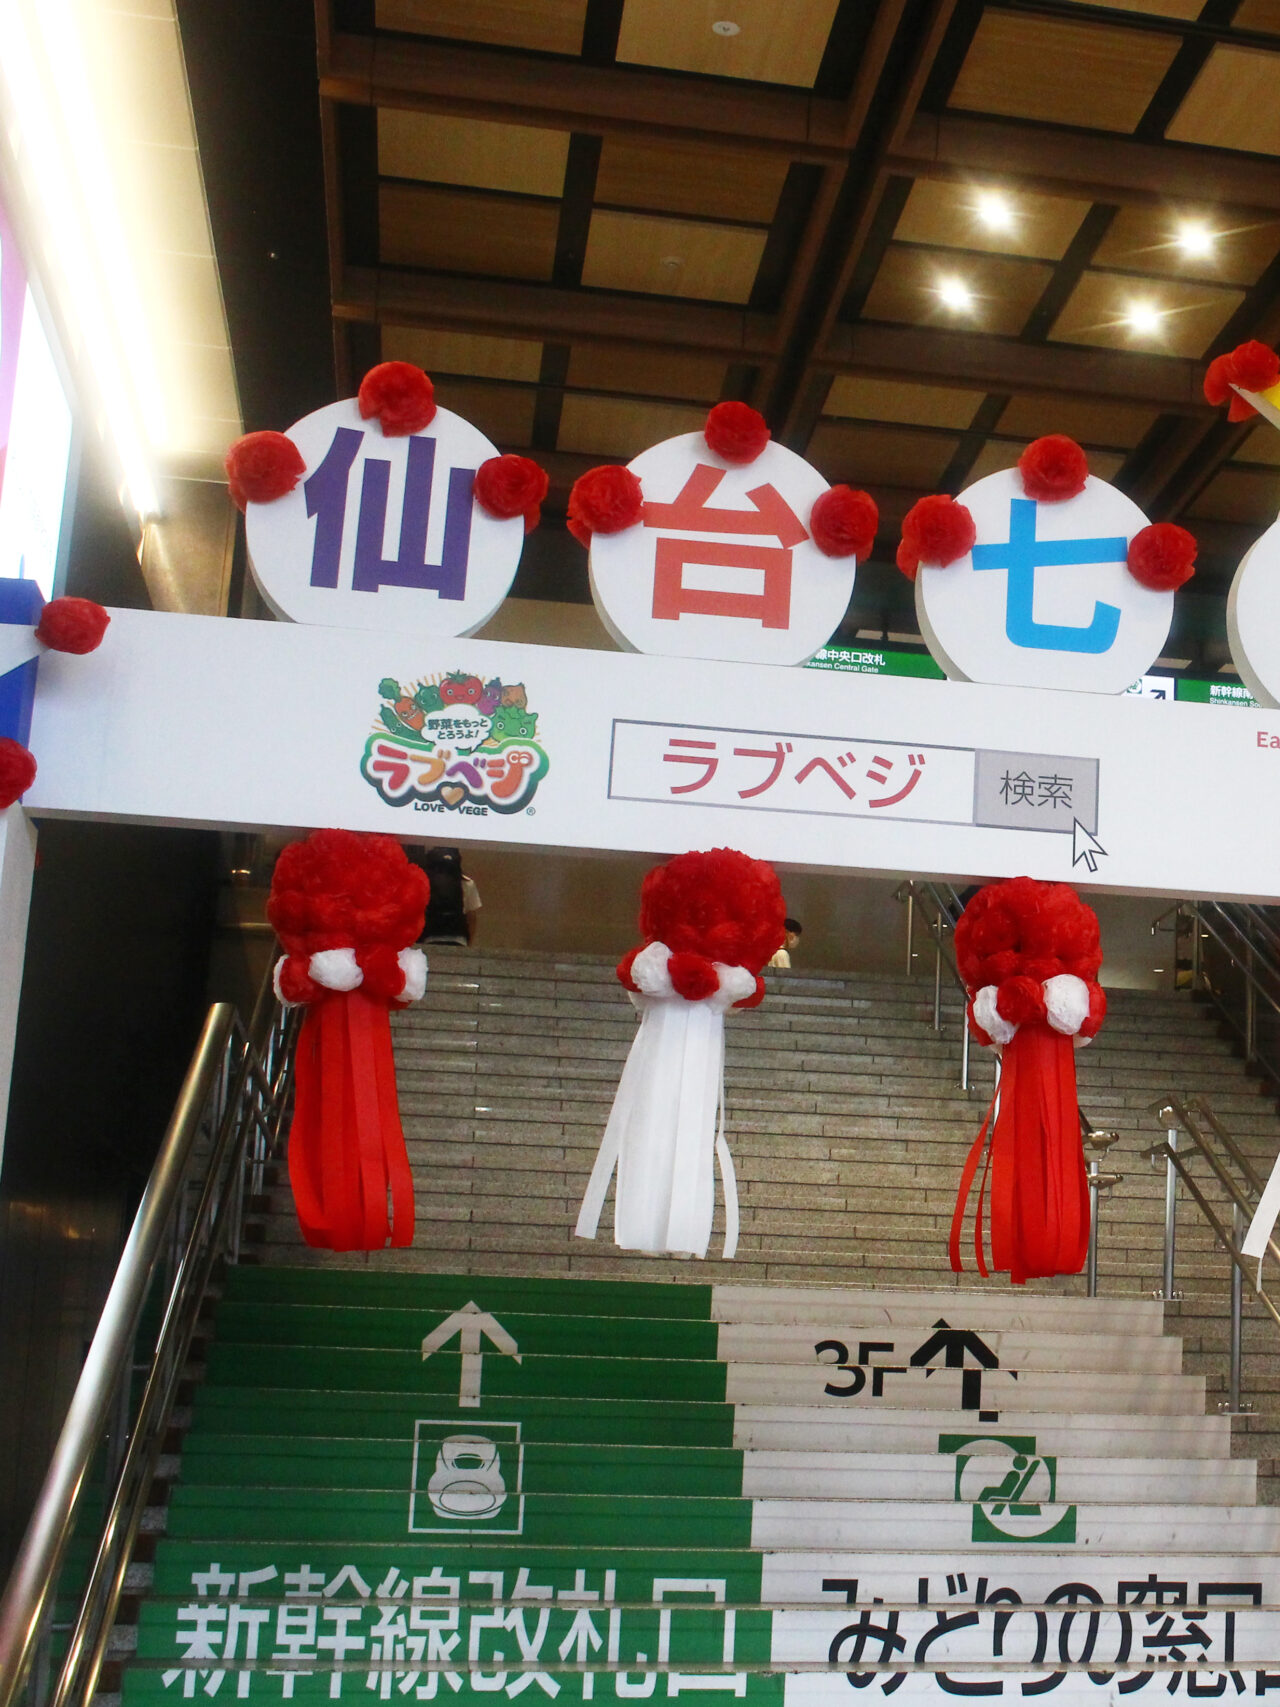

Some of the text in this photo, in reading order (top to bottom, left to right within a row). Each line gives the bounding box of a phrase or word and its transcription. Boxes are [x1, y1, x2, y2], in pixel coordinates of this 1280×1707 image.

[834, 663, 860, 672] Central
[861, 665, 879, 673] Gate
[428, 718, 488, 731] 野菜をもっと
[372, 744, 533, 799] ラブベジ
[663, 738, 1073, 809] ラブベジ 検索
[414, 802, 489, 816] LOVE VEGE
[814, 1340, 908, 1398] 3F
[162, 1562, 747, 1699] 新幹線改札口
